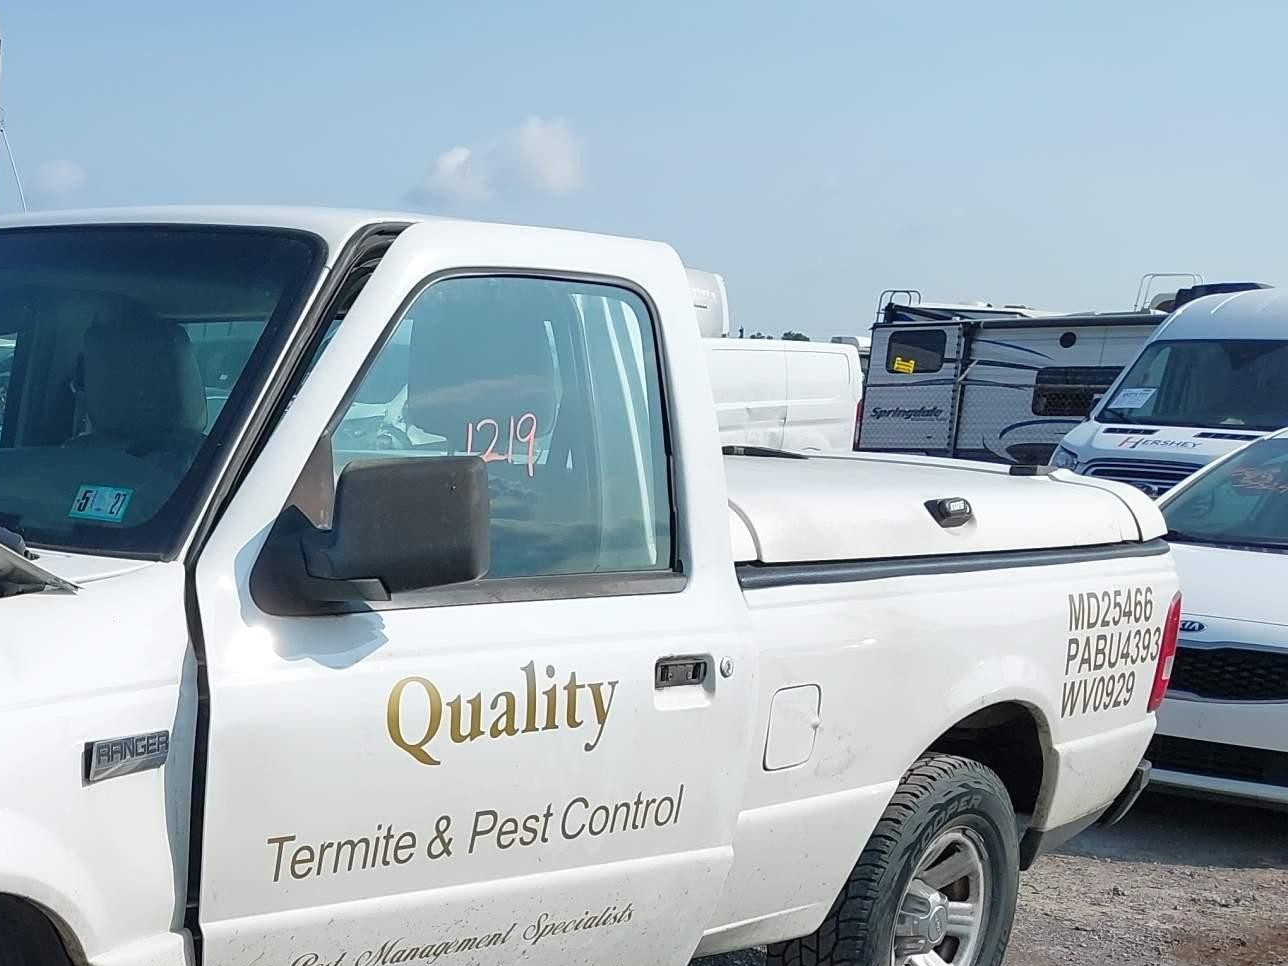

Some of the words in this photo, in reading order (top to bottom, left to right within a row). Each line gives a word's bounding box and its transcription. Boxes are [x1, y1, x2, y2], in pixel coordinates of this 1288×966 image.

[871, 406, 943, 419] Springdale
[467, 413, 537, 477] 1219
[1118, 436, 1203, 449] HERSHEY
[108, 492, 128, 515] 27
[1068, 586, 1154, 632] MD25466
[1065, 626, 1161, 676] PABU4393
[385, 660, 618, 766] Quality
[1061, 670, 1136, 719] WV0929
[96, 731, 169, 765] RANGER
[267, 823, 418, 883] Termite
[426, 815, 454, 860] &
[468, 804, 554, 854] Pest
[560, 784, 685, 841] Control
[523, 902, 635, 946] Specialists
